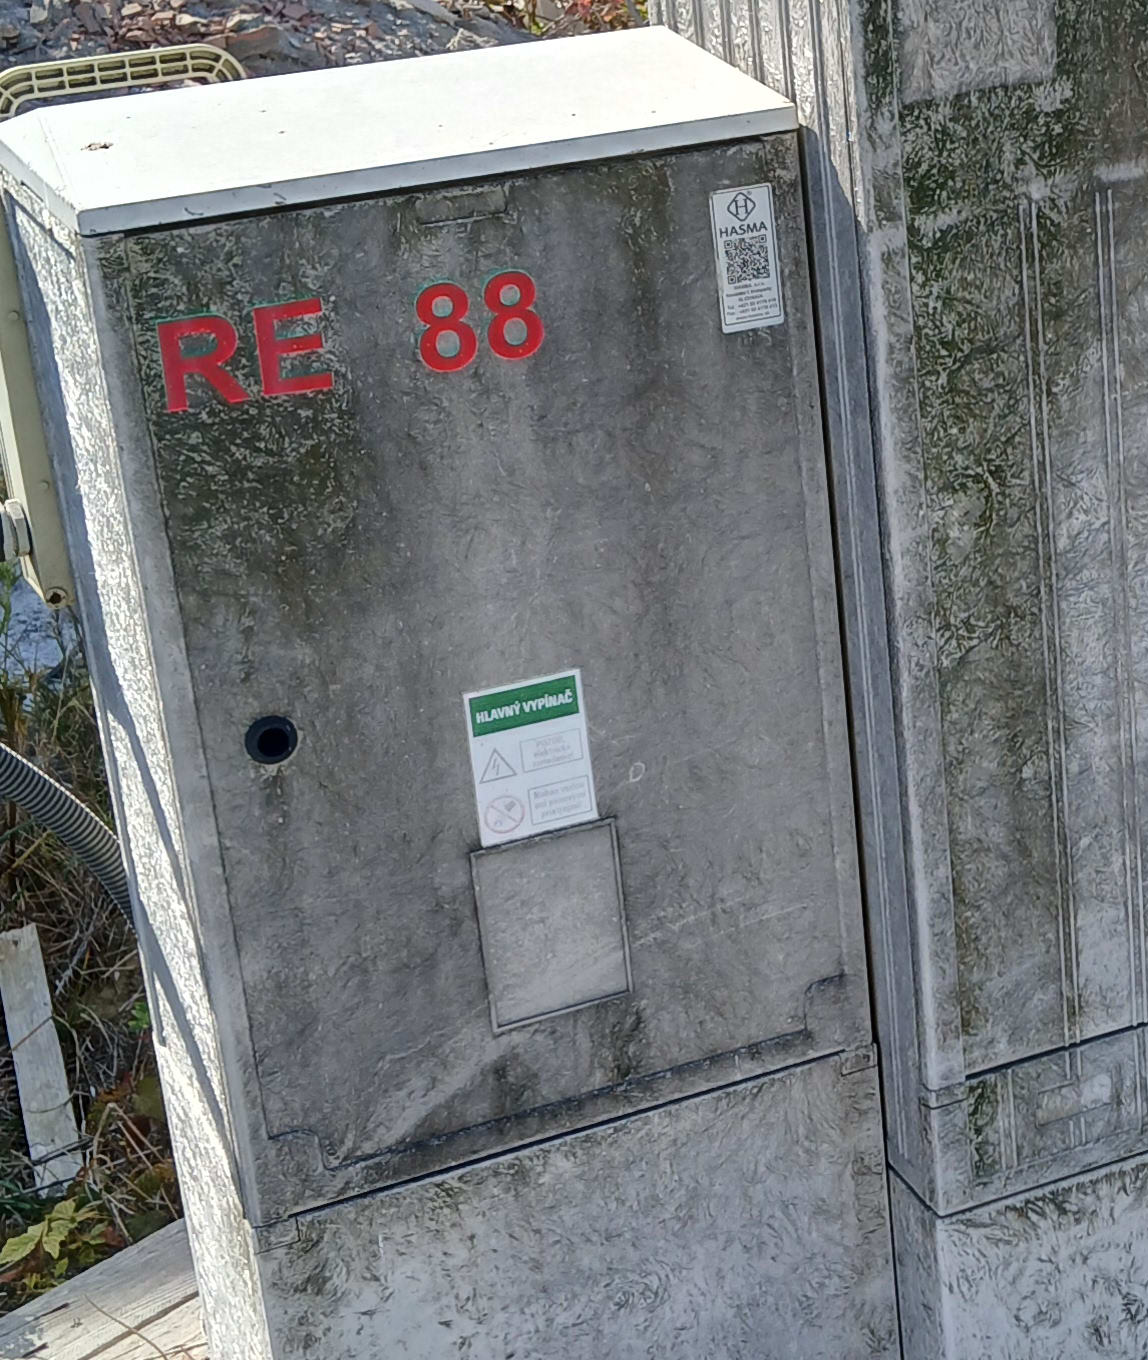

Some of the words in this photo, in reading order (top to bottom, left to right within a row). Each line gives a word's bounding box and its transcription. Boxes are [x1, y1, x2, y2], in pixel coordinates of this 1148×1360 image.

[719, 221, 768, 238] HASMA
[155, 296, 335, 413] RE
[415, 268, 545, 373] 88
[476, 700, 521, 724] HLAVNÝ
[522, 688, 574, 713] VYPÍNAČ
